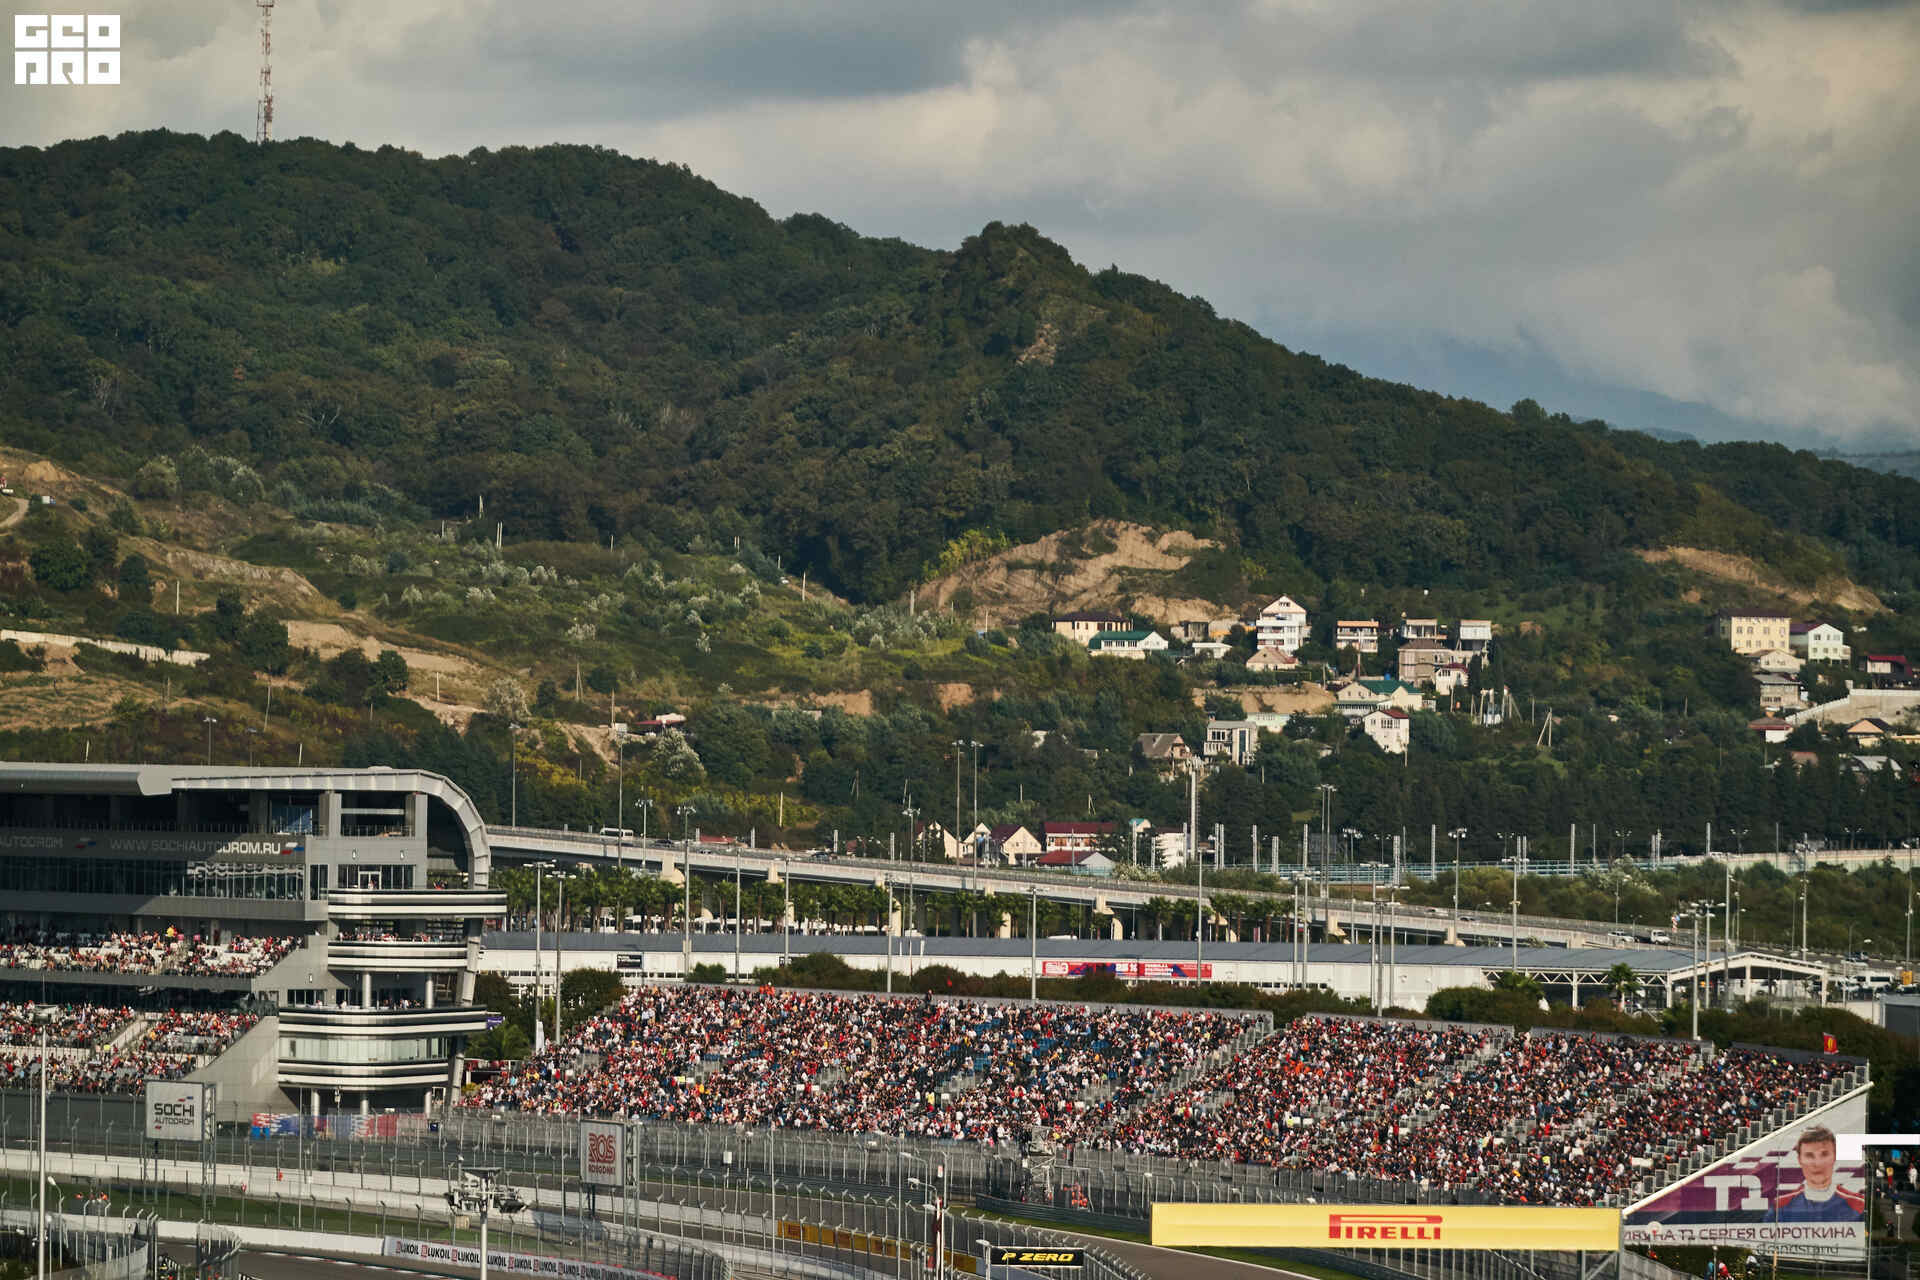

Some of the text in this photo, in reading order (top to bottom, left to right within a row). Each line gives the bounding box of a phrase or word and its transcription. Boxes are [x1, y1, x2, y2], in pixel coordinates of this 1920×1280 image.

[154, 1103, 194, 1117] SOCHI
[1704, 1175, 1769, 1211] T1
[1328, 1214, 1443, 1239] PIRELLI
[1700, 1227, 1756, 1240] СЕРГЕЯ
[1760, 1226, 1857, 1239] СИРОТКИНА
[400, 1243, 419, 1255] LUKOIL
[428, 1247, 450, 1259] LUKOIL
[457, 1250, 480, 1263] LUKOIL
[487, 1254, 507, 1267] LUKOIL
[514, 1258, 532, 1270] LUKOIL
[1001, 1252, 1075, 1262] P ZERO
